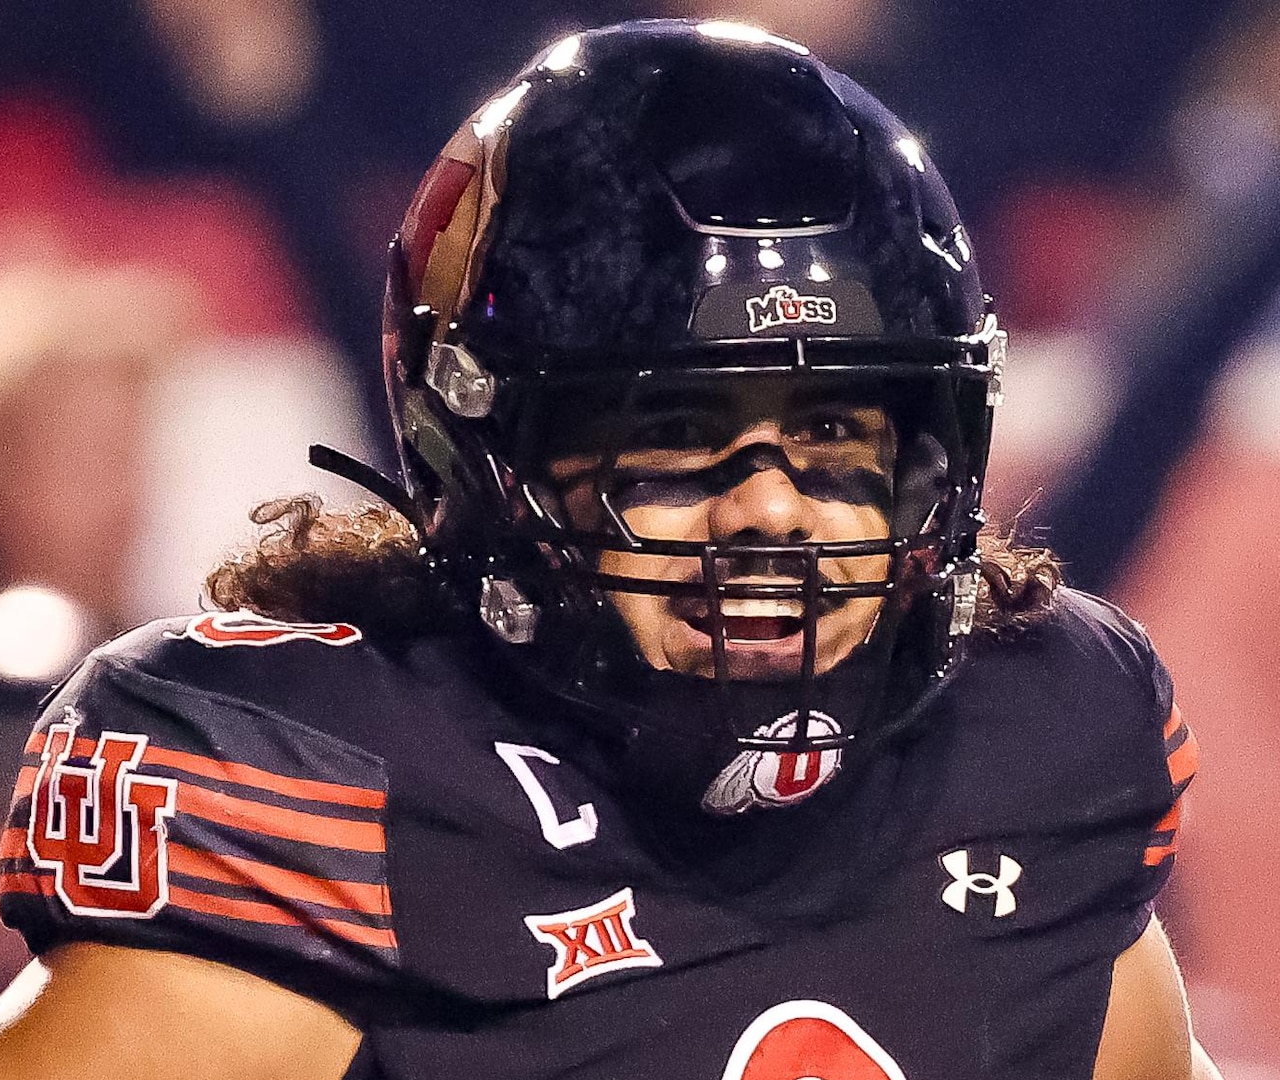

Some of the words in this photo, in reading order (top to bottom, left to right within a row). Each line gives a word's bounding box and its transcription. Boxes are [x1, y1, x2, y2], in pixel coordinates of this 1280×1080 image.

[750, 294, 834, 329] MUSS
[494, 740, 599, 850] C
[536, 898, 651, 984] XII
